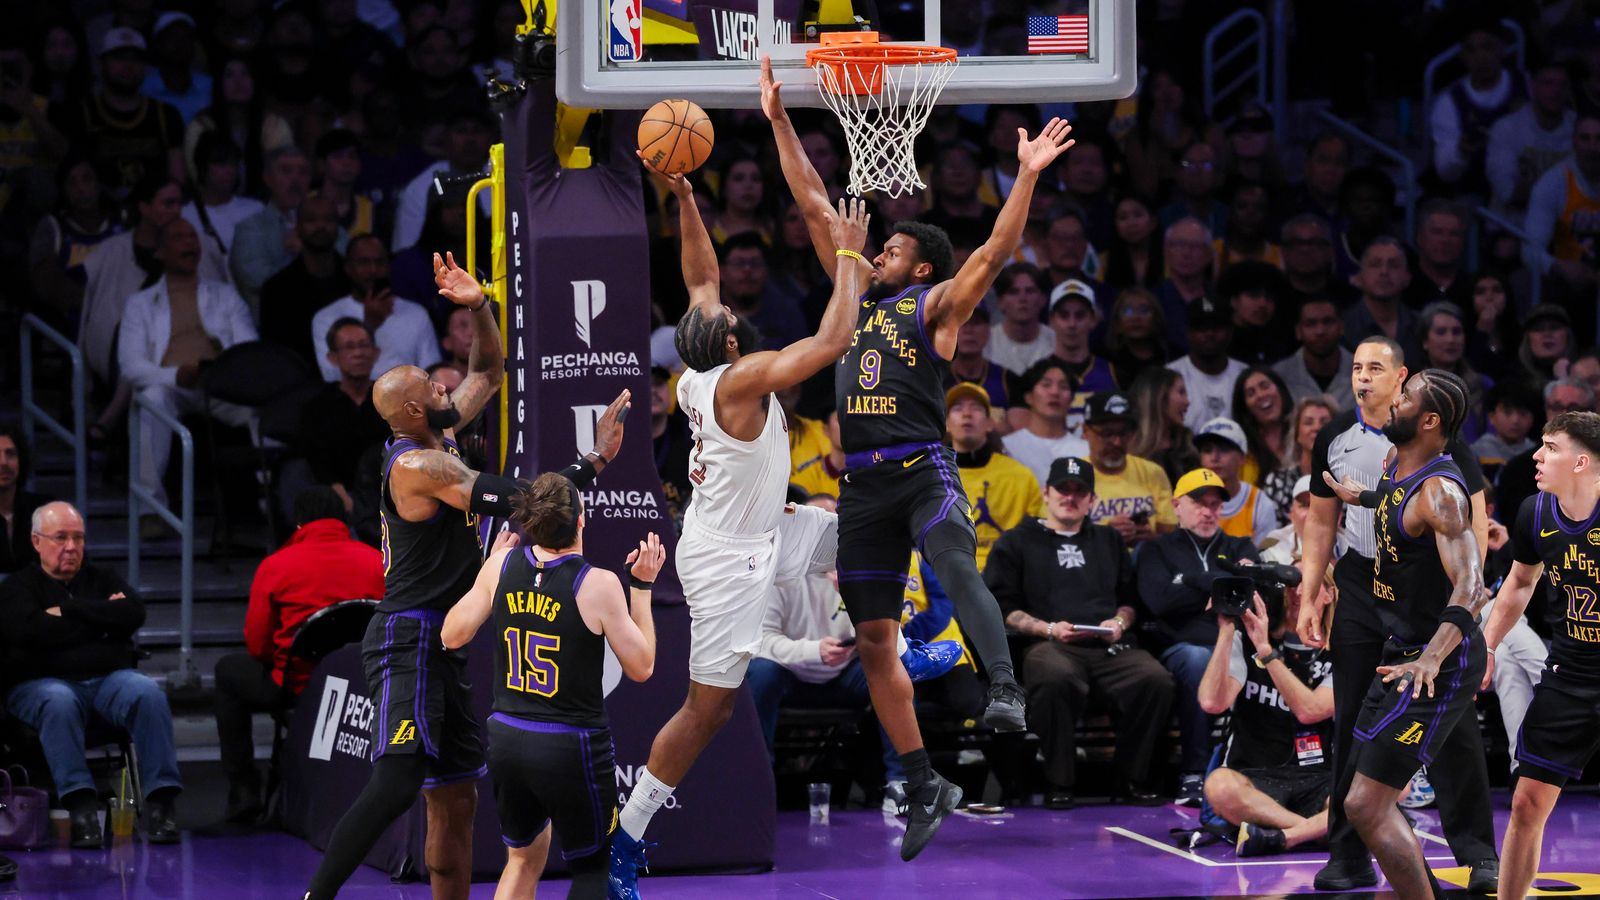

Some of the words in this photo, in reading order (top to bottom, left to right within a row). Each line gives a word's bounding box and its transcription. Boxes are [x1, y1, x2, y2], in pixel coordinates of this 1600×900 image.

[613, 45, 629, 57] NBA
[863, 309, 916, 367] ANGELES
[541, 352, 639, 369] PECHANGA
[859, 350, 881, 389] 9
[541, 367, 589, 380] RESORT
[595, 366, 641, 376] CASINO
[847, 396, 896, 414] LAKERS
[580, 491, 657, 507] HANGA
[1091, 496, 1155, 521] AKERS
[603, 508, 659, 520] CASINO
[1563, 544, 1600, 584] ANGEL
[506, 591, 561, 622] REAVES
[1563, 585, 1600, 622] 12
[504, 627, 560, 697] 15
[389, 720, 415, 744] LA
[1394, 721, 1423, 744] LA
[336, 731, 369, 759] RESORT
